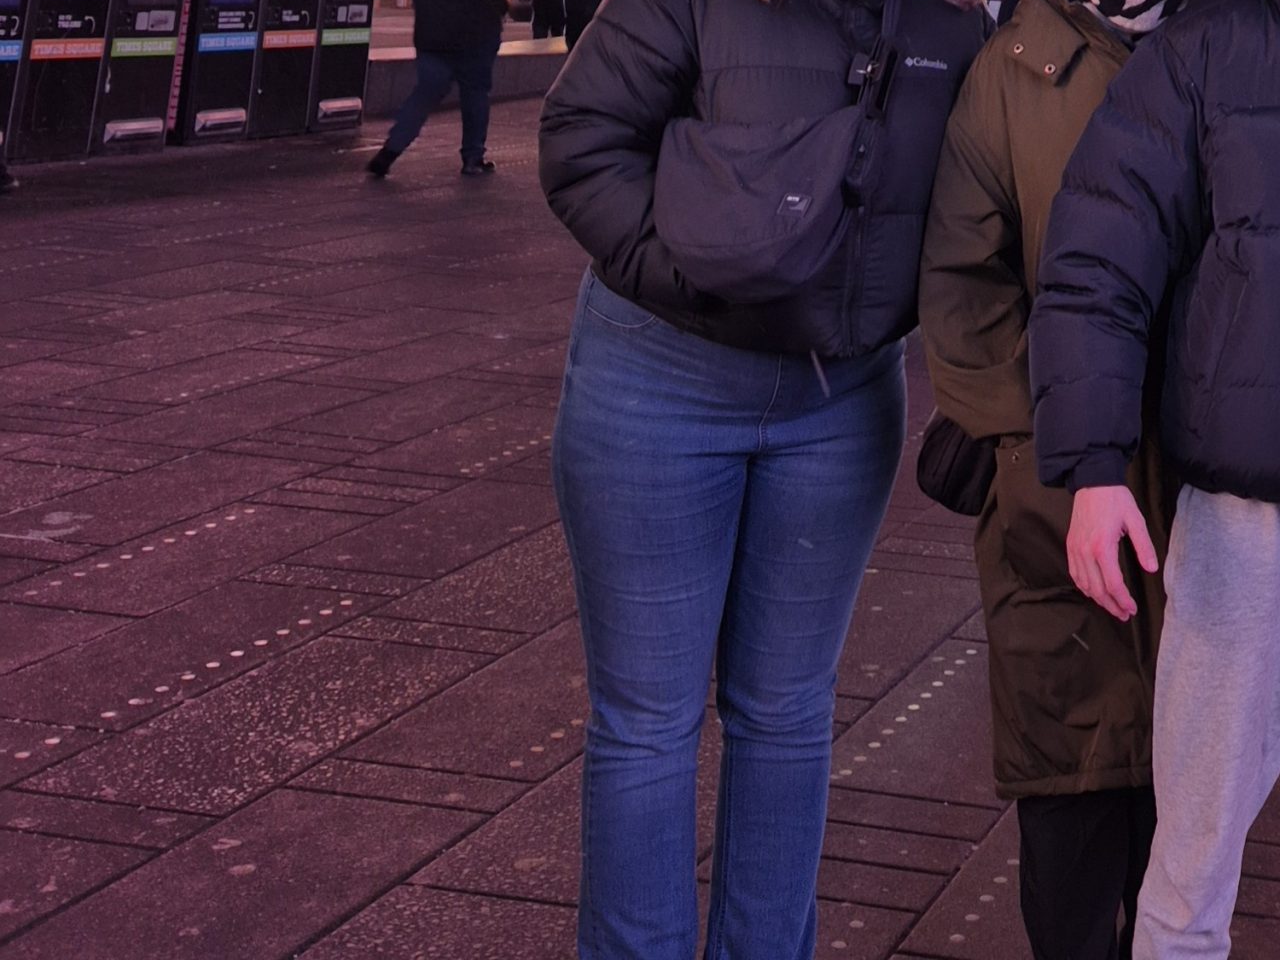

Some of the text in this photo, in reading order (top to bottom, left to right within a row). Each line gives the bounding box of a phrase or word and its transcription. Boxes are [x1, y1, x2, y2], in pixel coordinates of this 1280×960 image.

[116, 40, 174, 52] TIMES SQUARE
[201, 34, 257, 48] TIMES SQUARE
[33, 42, 104, 55] TIMES SQUARE
